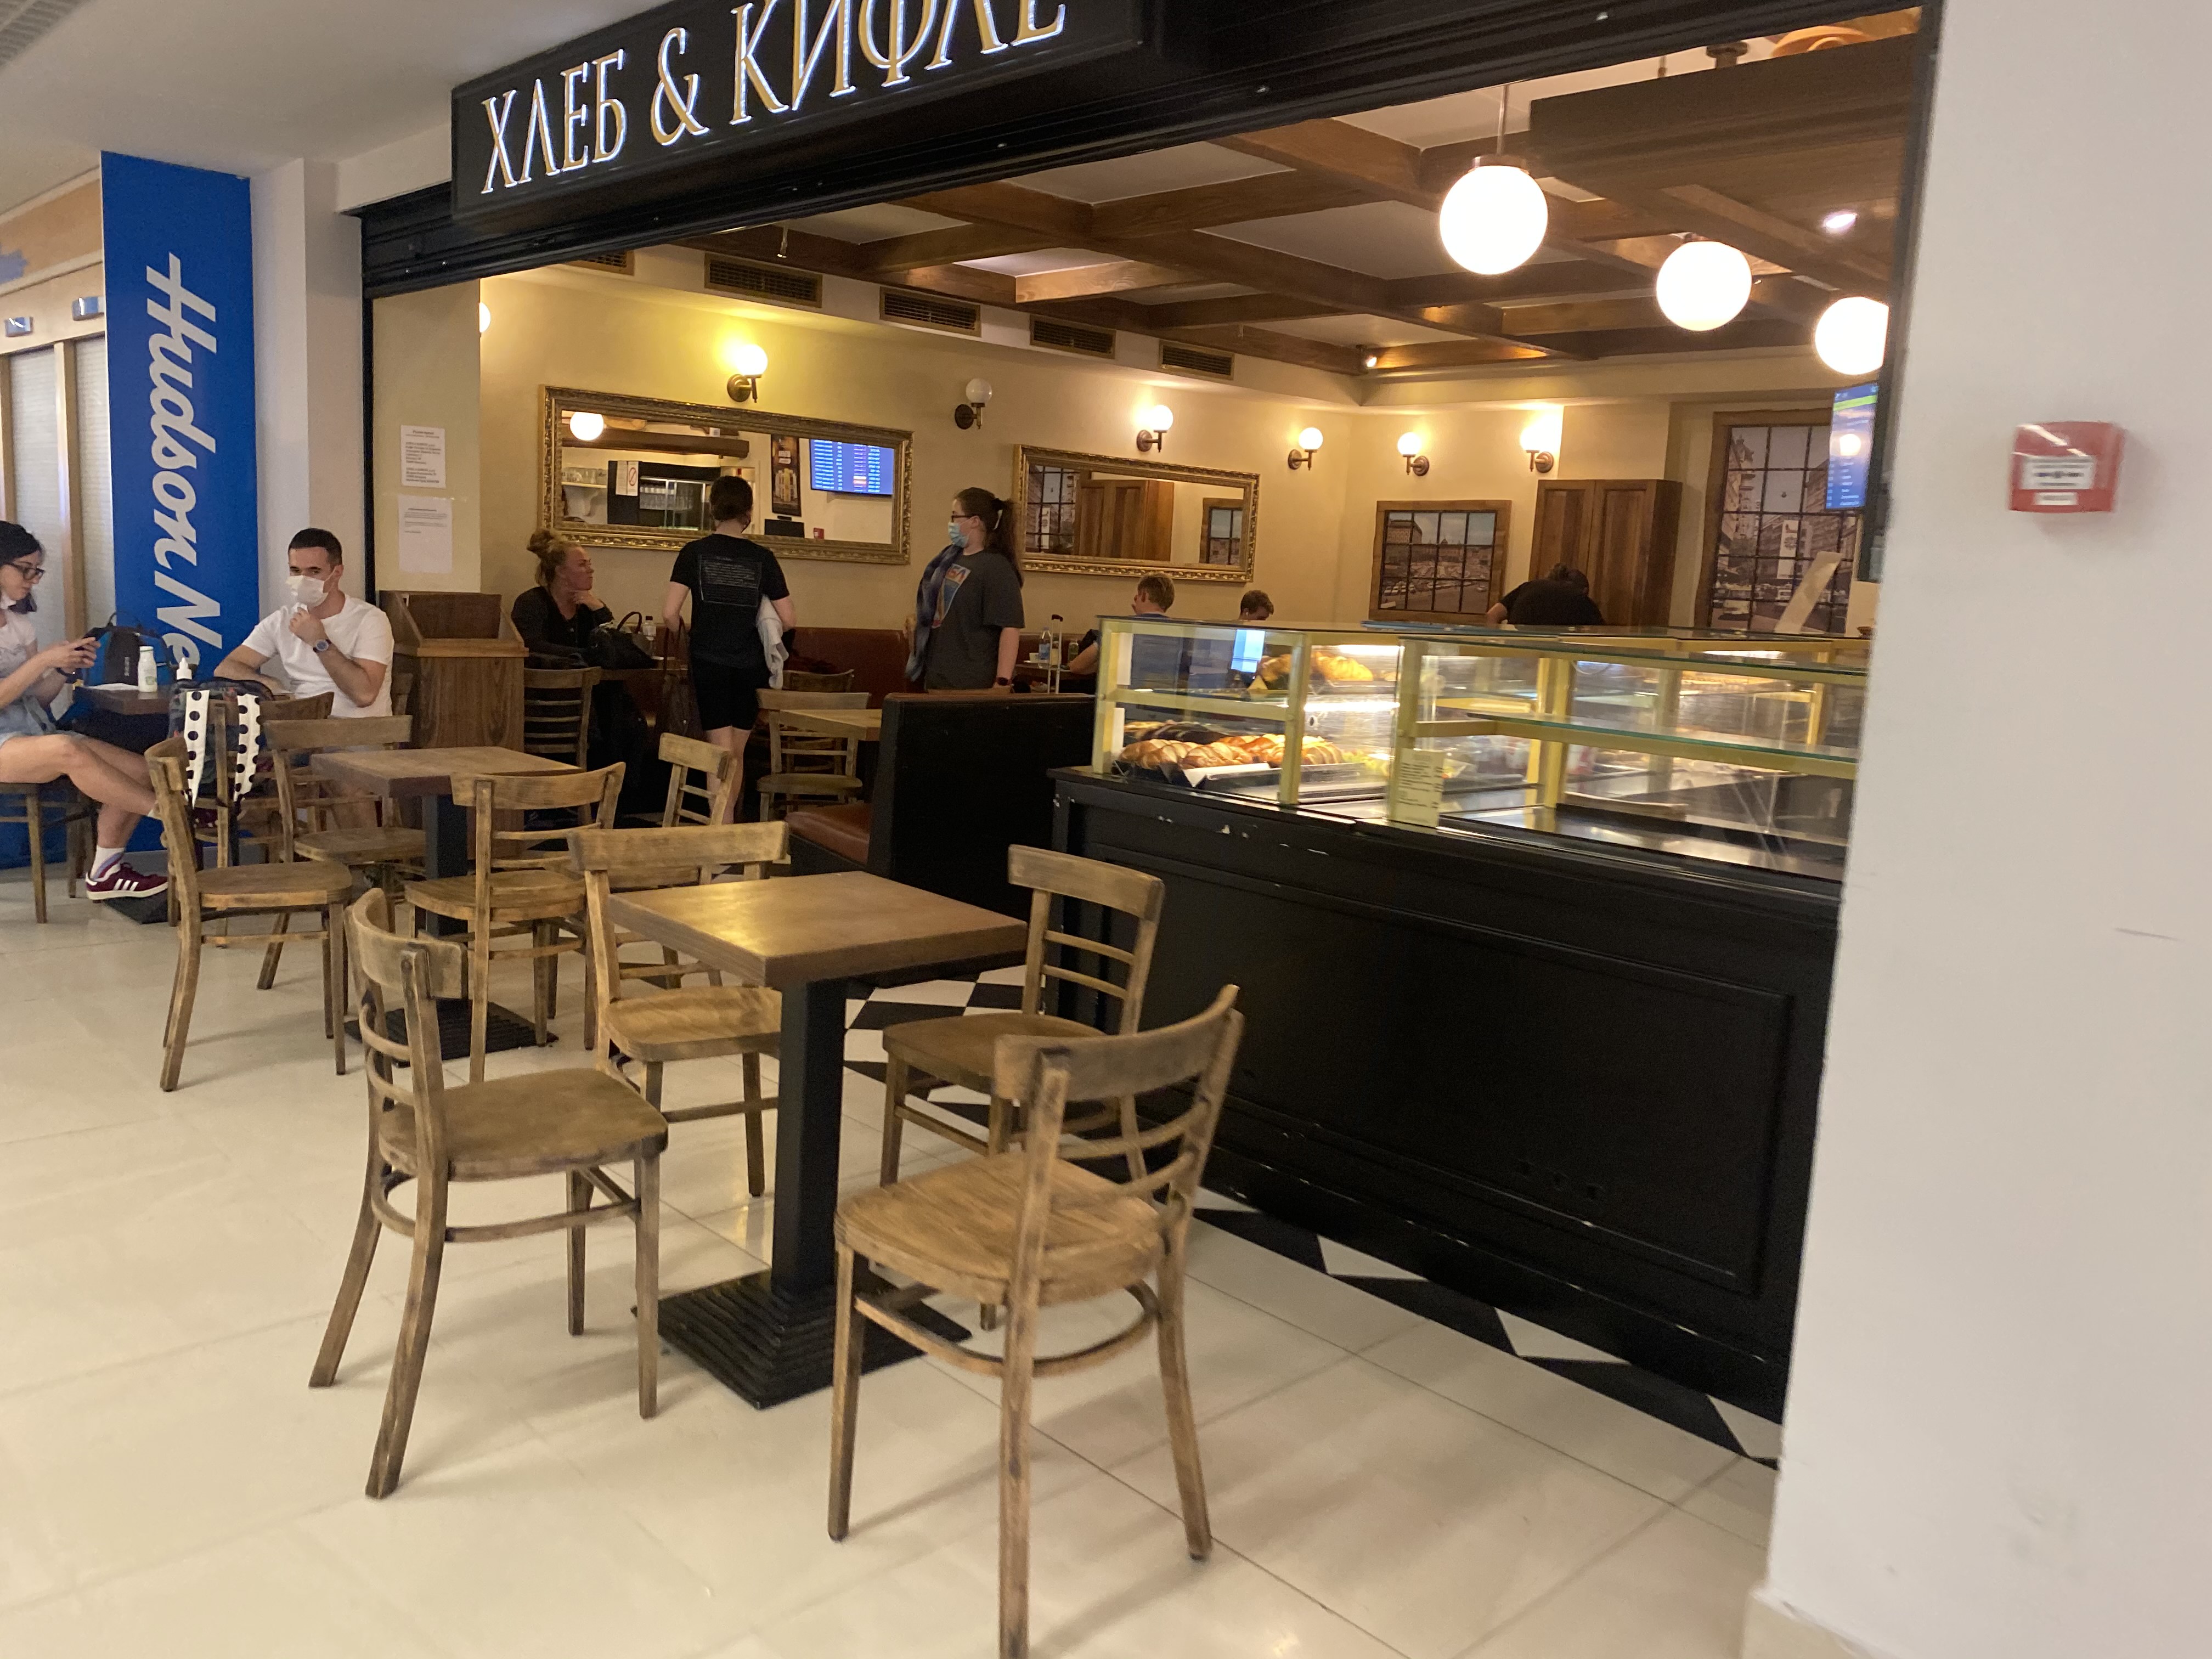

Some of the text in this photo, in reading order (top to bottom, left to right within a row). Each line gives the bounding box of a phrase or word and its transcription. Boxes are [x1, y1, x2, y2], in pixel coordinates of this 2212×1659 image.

[481, 48, 628, 194] ХЛЕБ
[650, 27, 709, 146] &
[146, 251, 217, 569] Hudson
